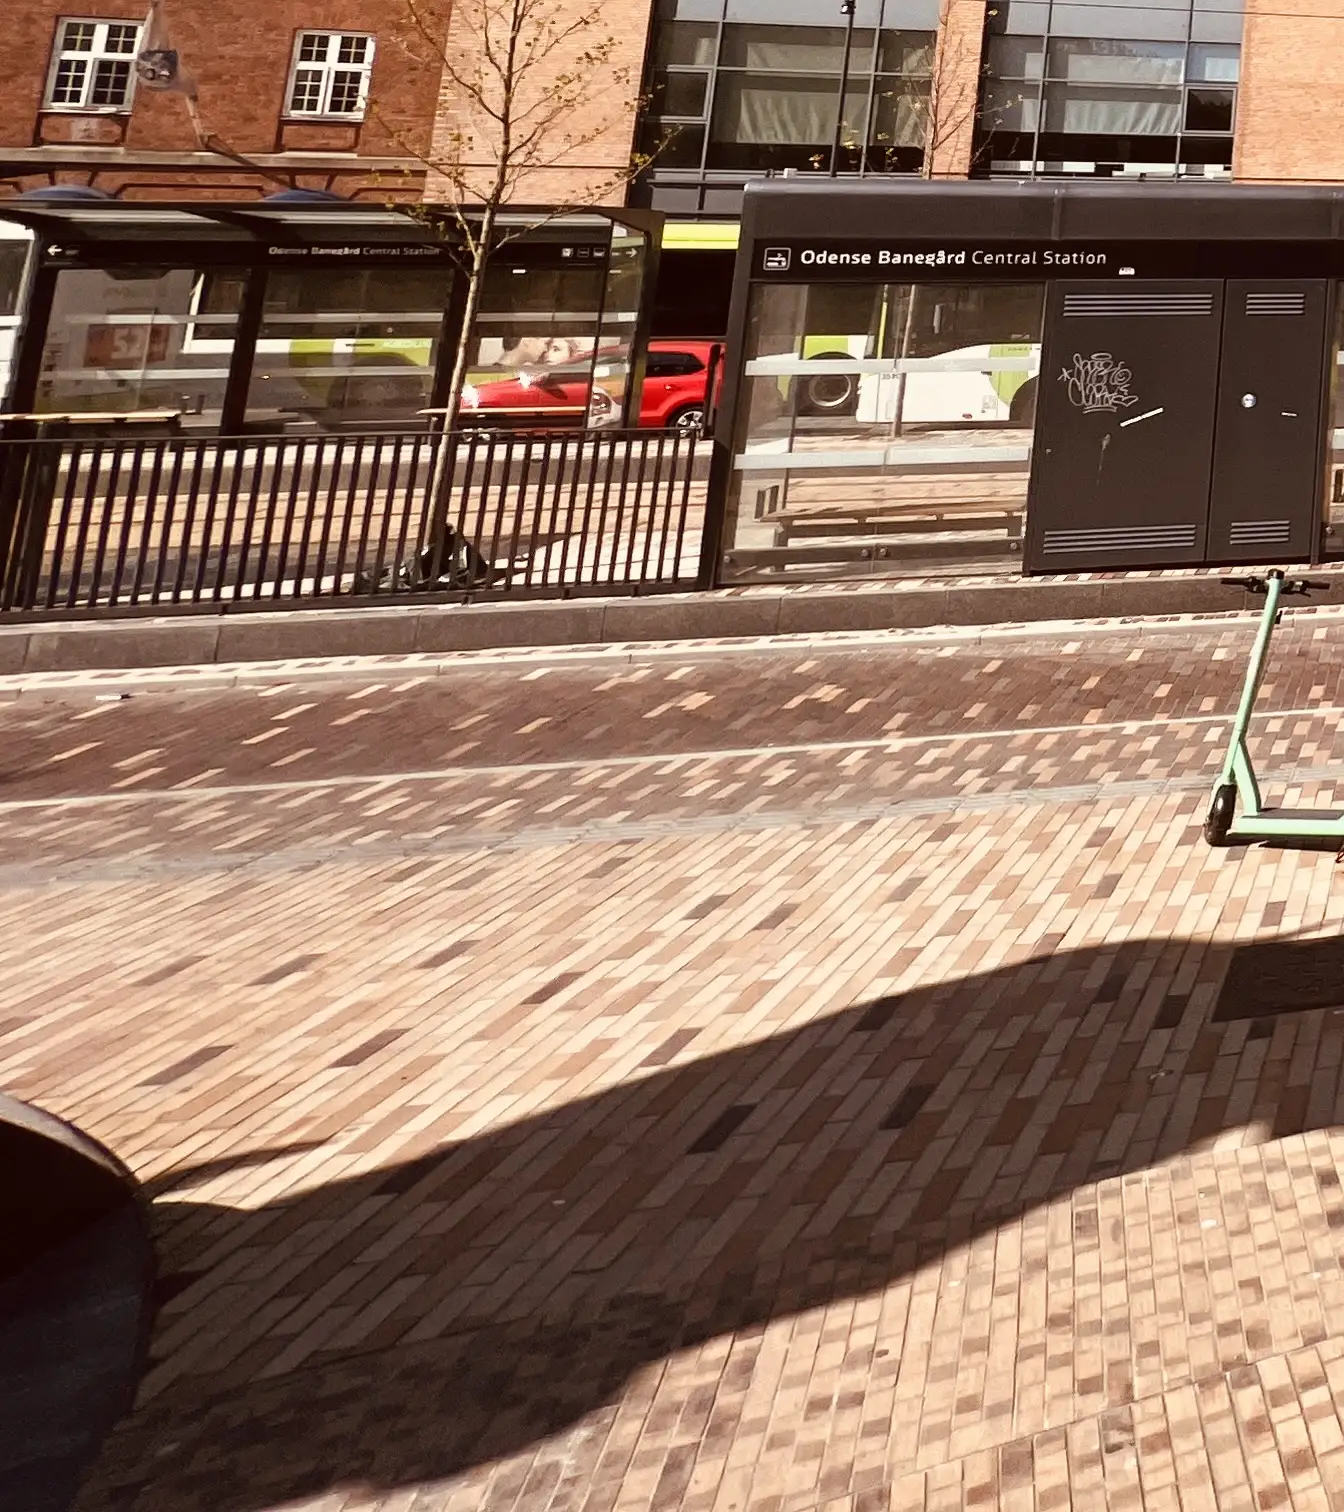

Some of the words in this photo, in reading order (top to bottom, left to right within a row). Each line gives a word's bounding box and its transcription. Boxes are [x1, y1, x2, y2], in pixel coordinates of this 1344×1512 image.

[363, 246, 400, 255] Central
[403, 246, 441, 255] Station
[800, 249, 872, 265] Odense
[878, 249, 966, 267] Banegård
[971, 250, 1037, 265] Central
[1043, 250, 1107, 265] Station
